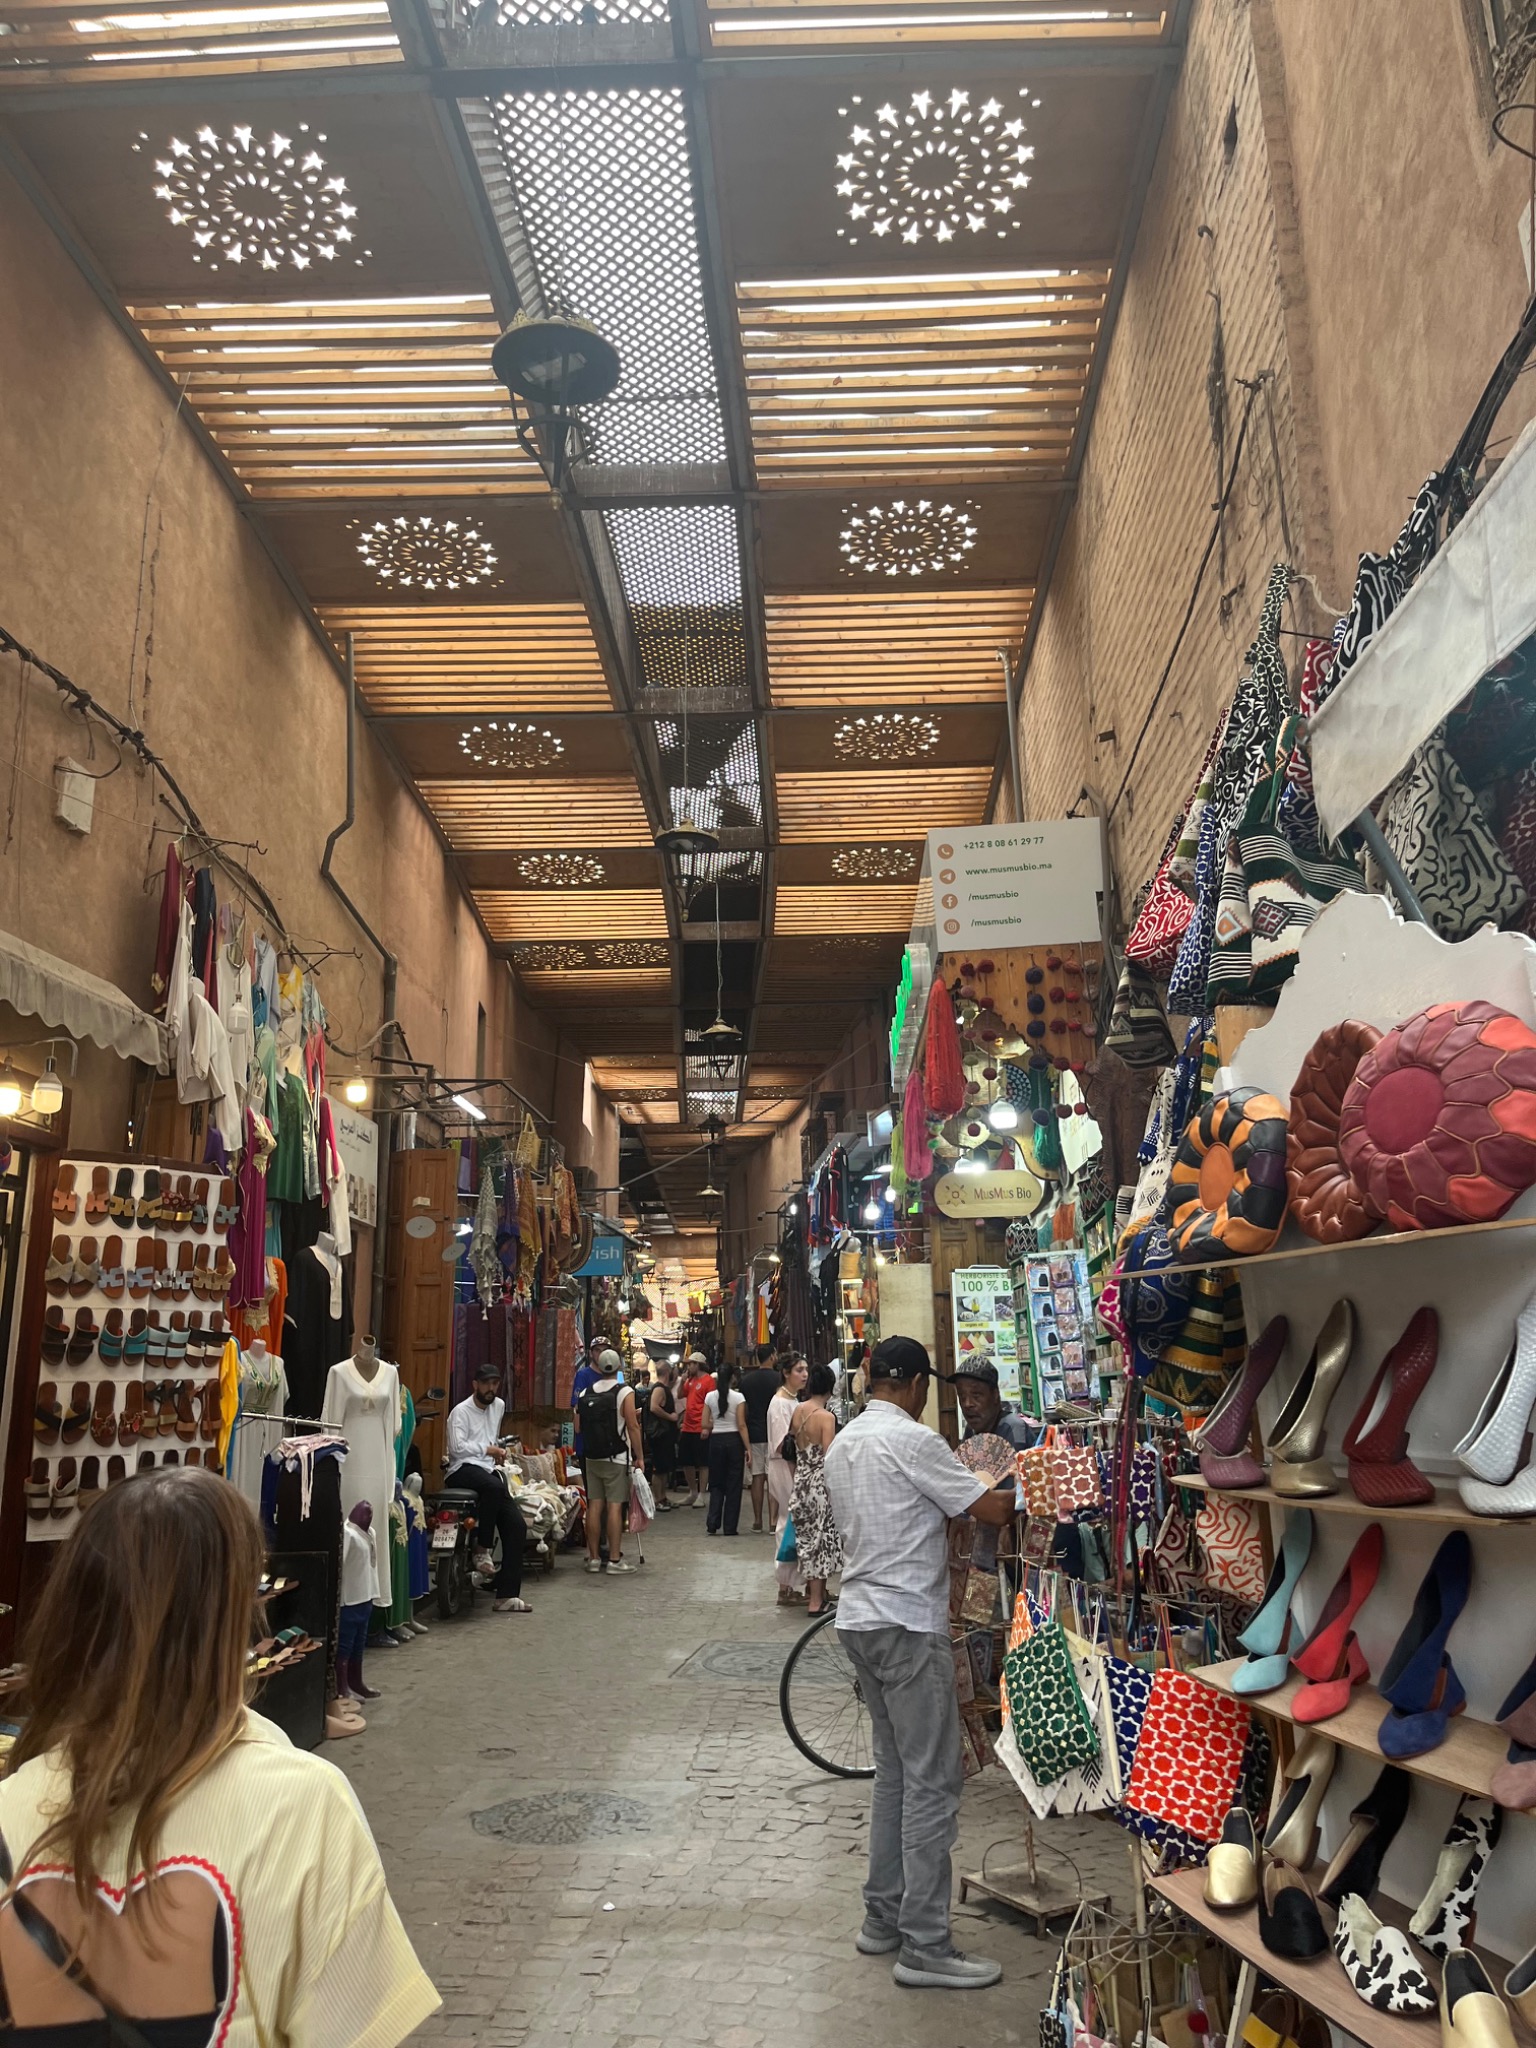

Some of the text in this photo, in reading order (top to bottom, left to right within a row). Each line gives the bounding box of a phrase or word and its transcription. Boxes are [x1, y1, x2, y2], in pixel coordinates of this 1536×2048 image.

[964, 841, 985, 849] +212
[995, 839, 1006, 848] 08
[1008, 838, 1018, 847] 61
[1021, 837, 1032, 846] 29
[1033, 836, 1044, 844] 77
[965, 863, 1052, 875] www.musmusbio.ma
[968, 891, 1019, 901] /musmusbio
[971, 916, 1022, 927] /musmusbio
[974, 1186, 1031, 1200] MusMus Bio
[591, 1245, 620, 1260] ish
[961, 1280, 983, 1292] 100
[986, 1280, 999, 1292] %
